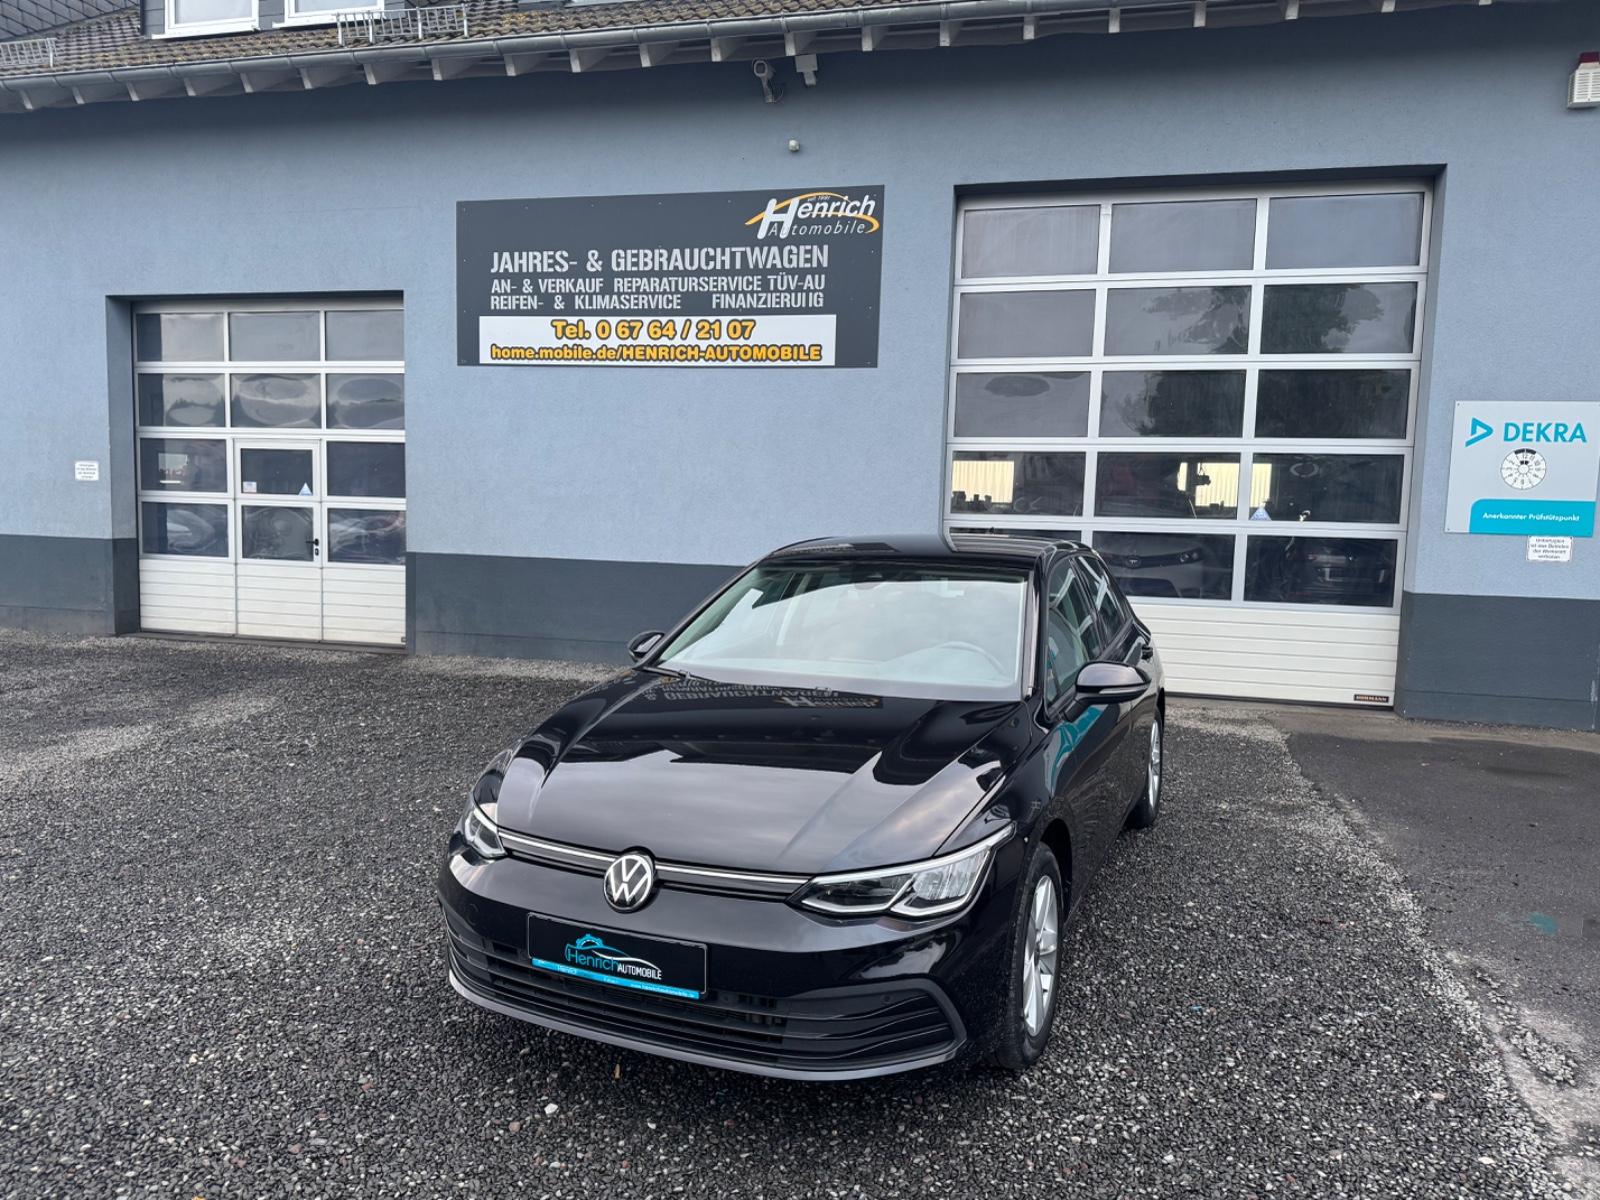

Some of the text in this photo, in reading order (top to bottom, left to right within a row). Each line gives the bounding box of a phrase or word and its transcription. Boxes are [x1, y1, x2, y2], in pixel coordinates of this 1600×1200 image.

[757, 195, 876, 239] Henrich
[768, 221, 866, 236] Atomobile
[490, 244, 829, 273] JAHRES- & GEBRAUCHTWAGEN
[491, 272, 826, 294] AN- & VERKAUF REPARATURSERVICE TÜV-AU
[490, 295, 544, 310] REIFEN-
[554, 295, 565, 310] &
[575, 294, 681, 310] KLIMASERVICE
[551, 319, 756, 340] Tel. 0 67 64 / 21 07
[491, 343, 823, 362] home.mobile.de/HENRICH-AUTOMOBILE
[1503, 422, 1588, 442] DEKRA
[567, 948, 619, 972] Henrich
[617, 964, 662, 980] AUTOMOBILE
